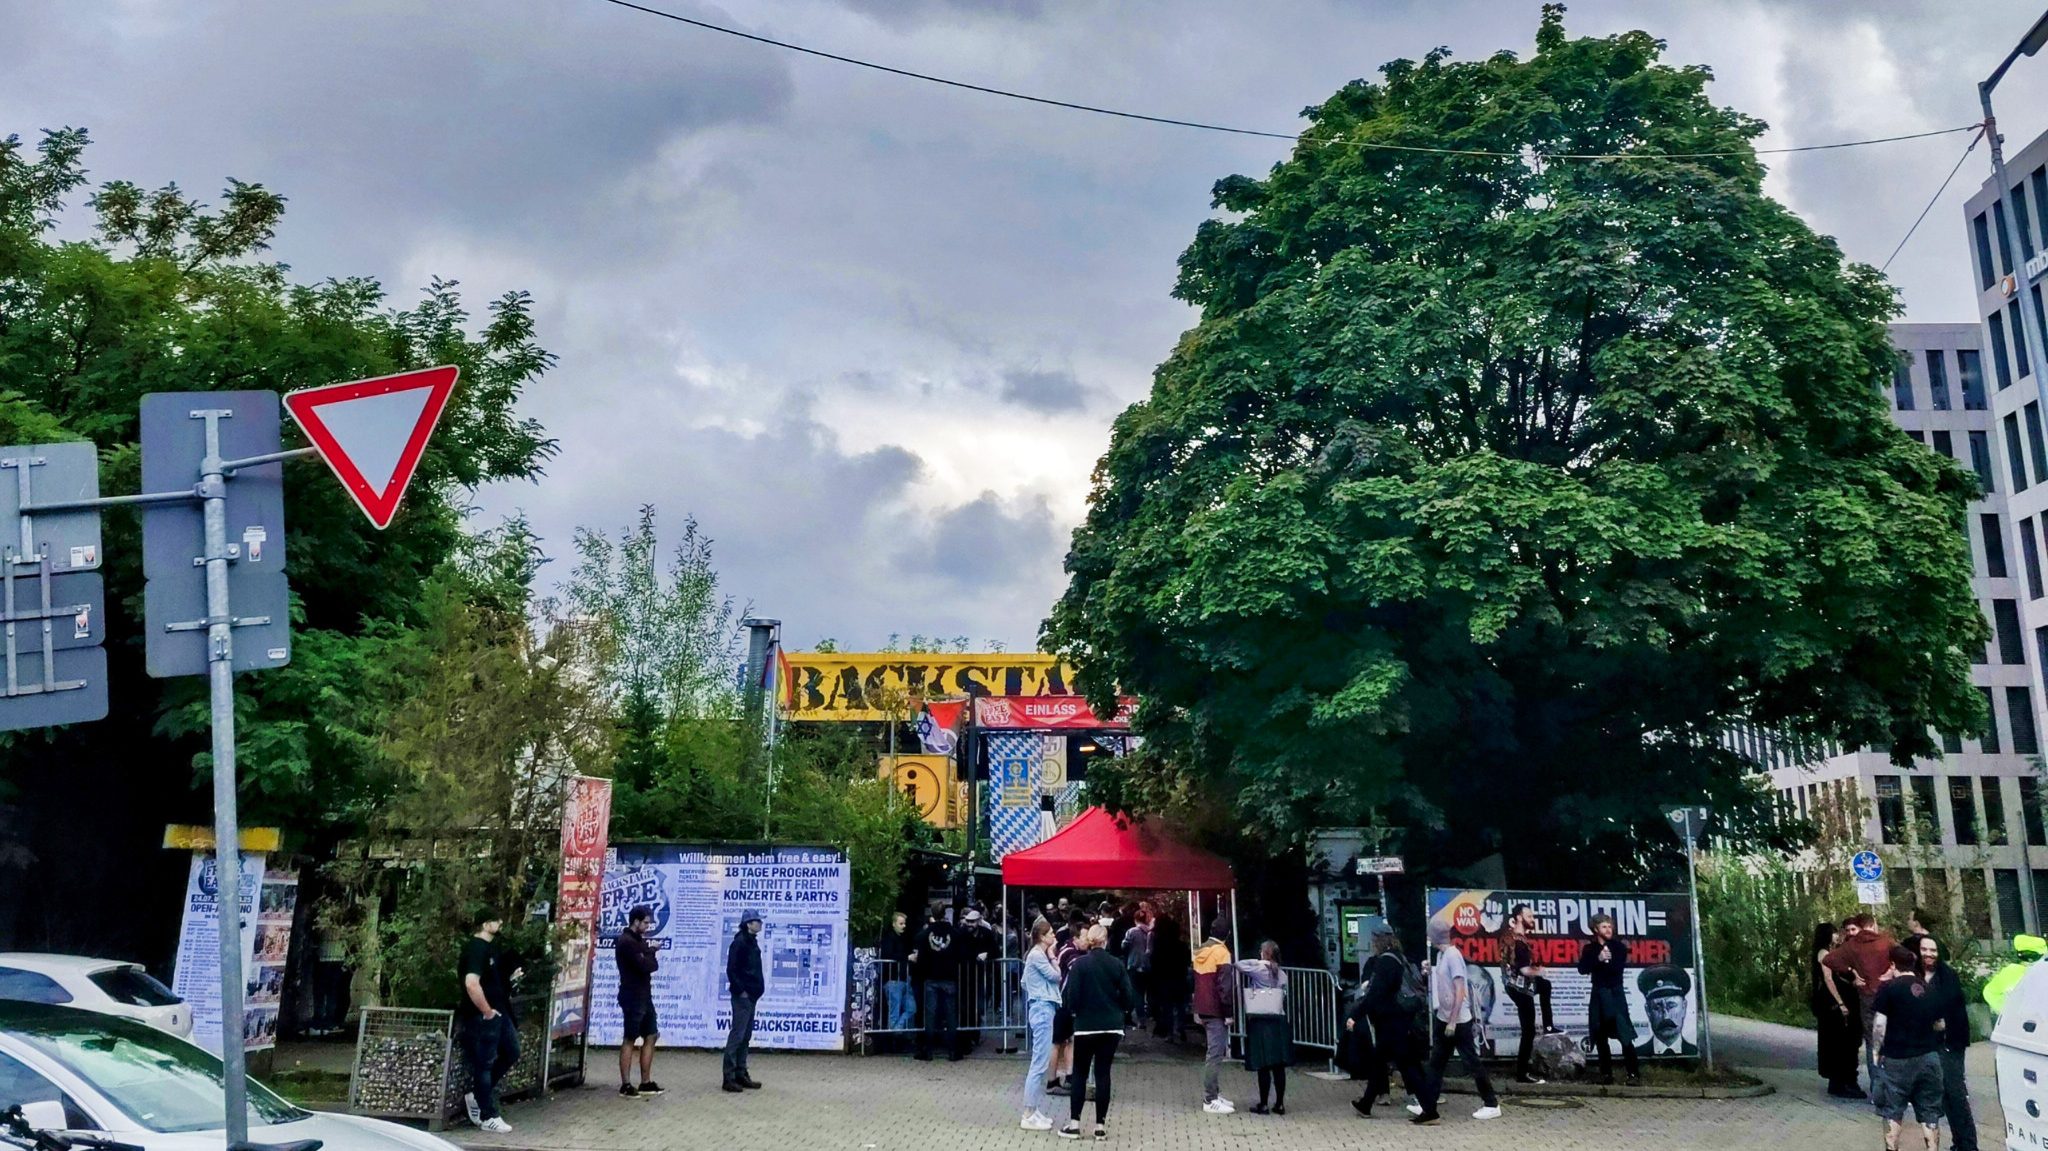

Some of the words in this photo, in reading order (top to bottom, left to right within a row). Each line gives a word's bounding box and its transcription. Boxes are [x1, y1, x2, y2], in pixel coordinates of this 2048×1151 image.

[788, 665, 1076, 711] BACKSTA
[1025, 704, 1077, 715] EINLASS
[679, 853, 744, 864] Willkommen
[748, 853, 775, 864] beim
[778, 853, 801, 863] free
[802, 852, 810, 863] &
[812, 852, 841, 864] easy!
[724, 867, 739, 877] 18
[741, 867, 770, 878] TAGE
[772, 867, 840, 878] PROGRAMM
[740, 879, 793, 890] EINTRITT
[794, 879, 825, 890] FREI!
[601, 880, 658, 909] FREE
[723, 890, 782, 901] KONZERTE
[784, 890, 793, 901] &
[795, 890, 839, 901] PARTYS
[601, 903, 661, 927] EAY
[1460, 906, 1475, 917] NO
[1456, 917, 1479, 927] WAR
[716, 1018, 838, 1033] WWBACKSTAGE.EU
